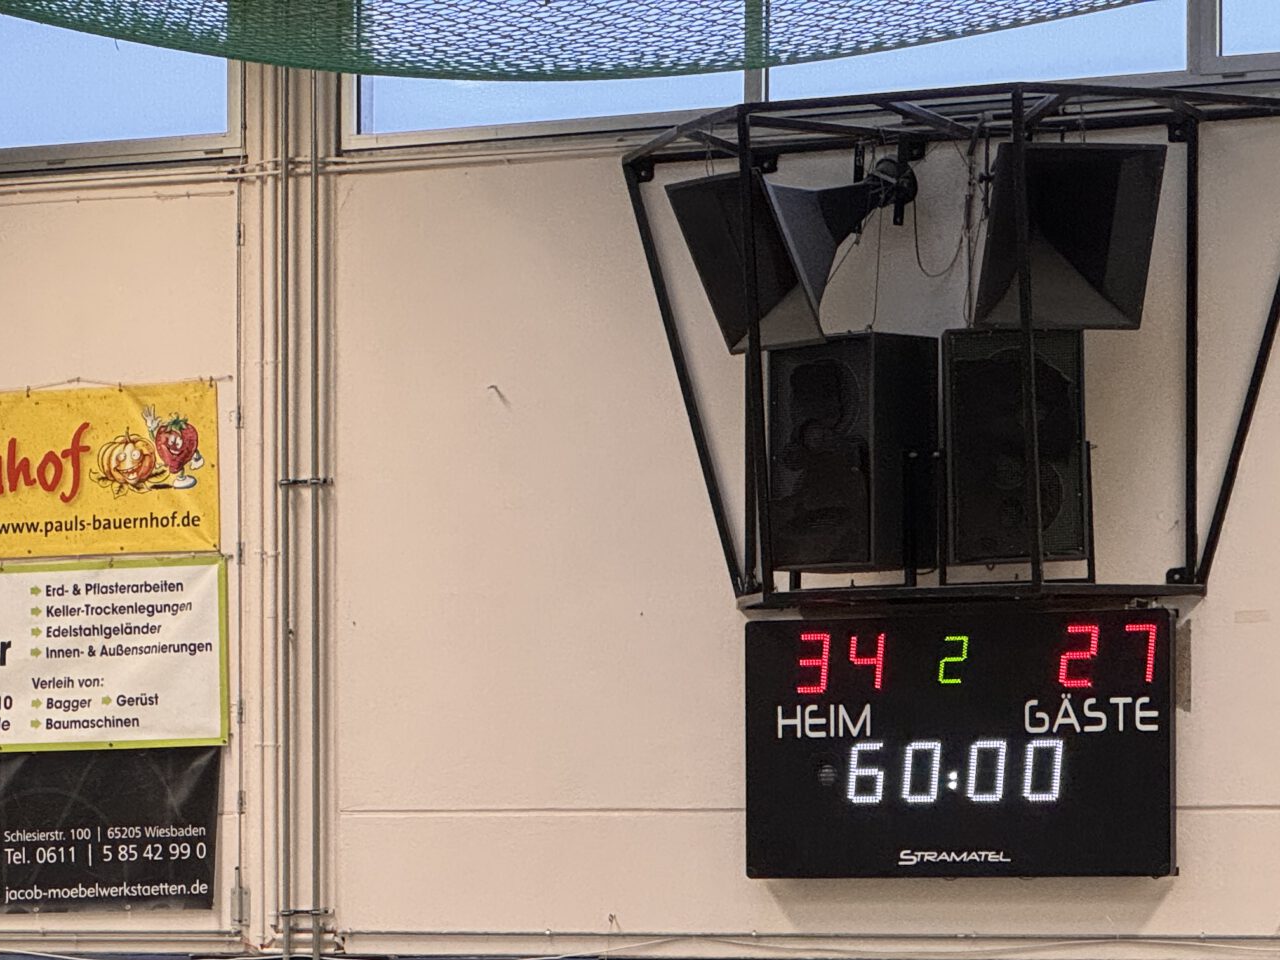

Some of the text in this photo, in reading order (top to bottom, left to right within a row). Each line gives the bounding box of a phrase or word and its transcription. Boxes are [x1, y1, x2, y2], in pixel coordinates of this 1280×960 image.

[45, 580, 184, 598] Erd- & Pflasterarbeiten
[45, 600, 192, 618] Keller-Trockenlegungen
[45, 622, 162, 640] Edelstahlgeländer
[45, 640, 213, 659] Innen- & Außensanierungen
[1058, 624, 1158, 688] 27
[797, 632, 887, 694] 34
[938, 636, 969, 684] 2
[31, 676, 104, 690] Verleih von:
[46, 695, 92, 712] Bagger
[116, 692, 159, 708] Gerüst
[45, 714, 140, 730] Baumaschinen
[777, 704, 872, 739] HEIM
[1024, 693, 1159, 734] GÄSTE
[847, 739, 1064, 803] 60:00
[4, 824, 206, 843] Schlesierstr. 100 65205 Wiesbaden
[4, 842, 207, 865] Tel. 0611 5 85 42 99 0
[898, 850, 1011, 866] STRAMATEL
[4, 880, 208, 903] jacob-moebelwerkstaetten.de
